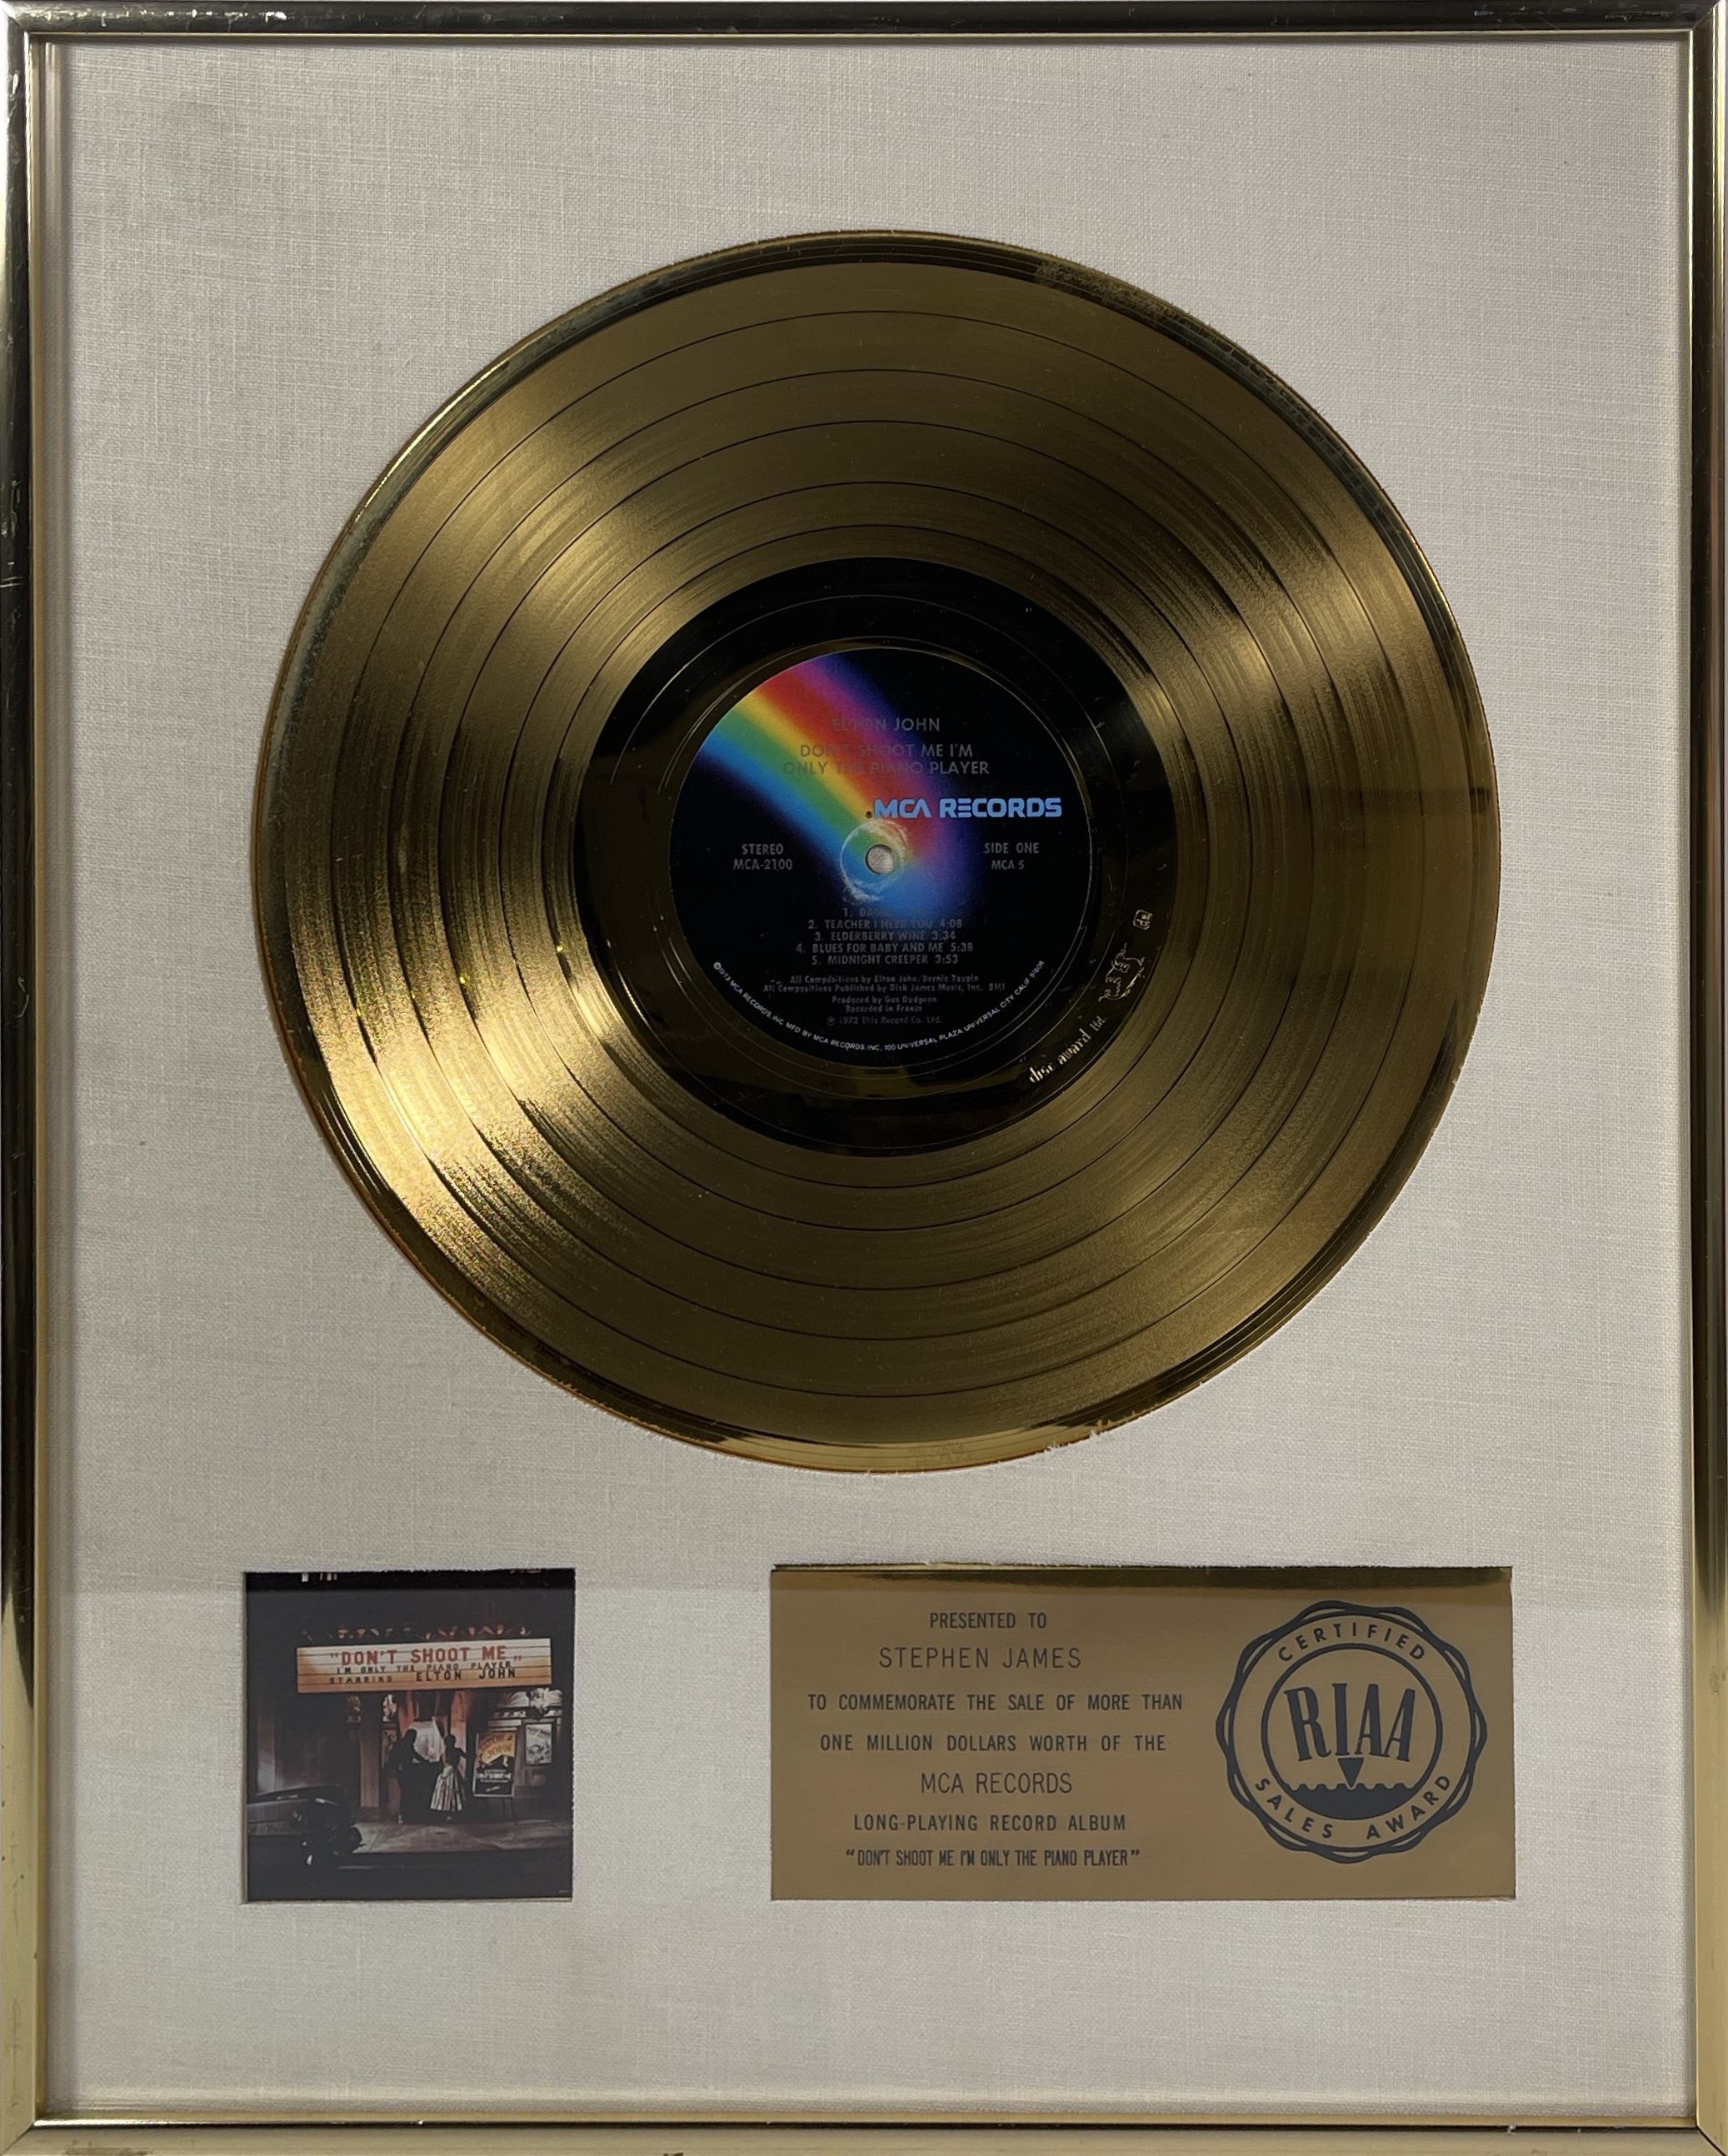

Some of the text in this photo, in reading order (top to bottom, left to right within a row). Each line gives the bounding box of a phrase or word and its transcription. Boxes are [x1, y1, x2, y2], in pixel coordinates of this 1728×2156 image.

[832, 718, 940, 731] ELTON JOHN
[859, 744, 915, 757] SHOOT
[921, 744, 943, 757] ME
[949, 744, 973, 757] I'M
[782, 761, 990, 775] ONLY THE PIANO PLAYER
[874, 797, 1062, 818] MCA RECORDS
[742, 843, 784, 855] STEREO
[983, 841, 1040, 854] SIDE ONE
[733, 858, 793, 871] MCA-2100
[991, 859, 1026, 870] MCA 5
[824, 919, 871, 929] TEACHER
[881, 919, 907, 929] NEED
[831, 931, 895, 941] ELDERBERRY
[899, 931, 926, 941] WINE
[812, 943, 843, 953] BLUES
[847, 943, 866, 953] FOR
[870, 943, 899, 952] BABY
[901, 943, 925, 952] AND
[928, 942, 944, 952] ME
[827, 955, 881, 965] MIDNIGHT
[885, 955, 929, 965] CREEPER
[935, 954, 958, 964] 3:53
[789, 976, 802, 984] All
[804, 976, 859, 985] Compositions
[861, 976, 871, 984] by
[874, 975, 896, 983] Elton
[951, 974, 979, 984] Taupin
[763, 984, 775, 993] All
[777, 984, 832, 994] Compositions
[835, 984, 874, 992] Published
[876, 984, 886, 993] by
[889, 983, 907, 992] Dick
[911, 984, 936, 992] James
[832, 996, 869, 1004] Produced
[871, 996, 882, 1005] by
[902, 996, 937, 1005] Dudgeon
[730, 980, 743, 994] MCA
[813, 1034, 828, 1044] MCA
[897, 1037, 938, 1050] UNIVERSAL
[938, 1029, 963, 1041] PLAZA
[963, 1006, 1001, 1031] UNIVERSAL
[1000, 994, 1015, 1009] CITY
[846, 1005, 883, 1013] Recorded
[839, 1016, 859, 1025] 1972
[862, 1016, 878, 1025] This
[881, 1016, 908, 1025] Record
[1057, 1027, 1091, 1066] award
[929, 1612, 1047, 1629] PRESENTED TO
[1277, 1622, 1426, 1662] CERTIFIED
[410, 1647, 471, 1664] SHOOT
[878, 1646, 1082, 1669] STEPHEN JAMES
[361, 1665, 386, 1674] ONLY
[427, 1663, 459, 1671] PIANO
[470, 1661, 511, 1670] PLAYER
[329, 1667, 516, 1684] STARRING ELTON JOHN
[807, 1694, 1183, 1710] TO COMMEMORATE THE SALE OF MORE THAN
[1284, 1683, 1416, 1762] RIAA
[820, 1734, 1166, 1751] ONE MILLION DOLLARS WORTH OF THE
[921, 1772, 1073, 1794] MCA RECORDS
[1254, 1775, 1451, 1840] SALES AWARD
[853, 1814, 1126, 1831] LONG-PLAYING RECORD ALBUM
[896, 1849, 933, 1866] SHOOT
[938, 1849, 955, 1866] ME
[960, 1849, 975, 1866] I'M
[980, 1849, 1010, 1866] ONLY
[1016, 1849, 1038, 1866] THE
[1043, 1849, 1077, 1866] PIANO
